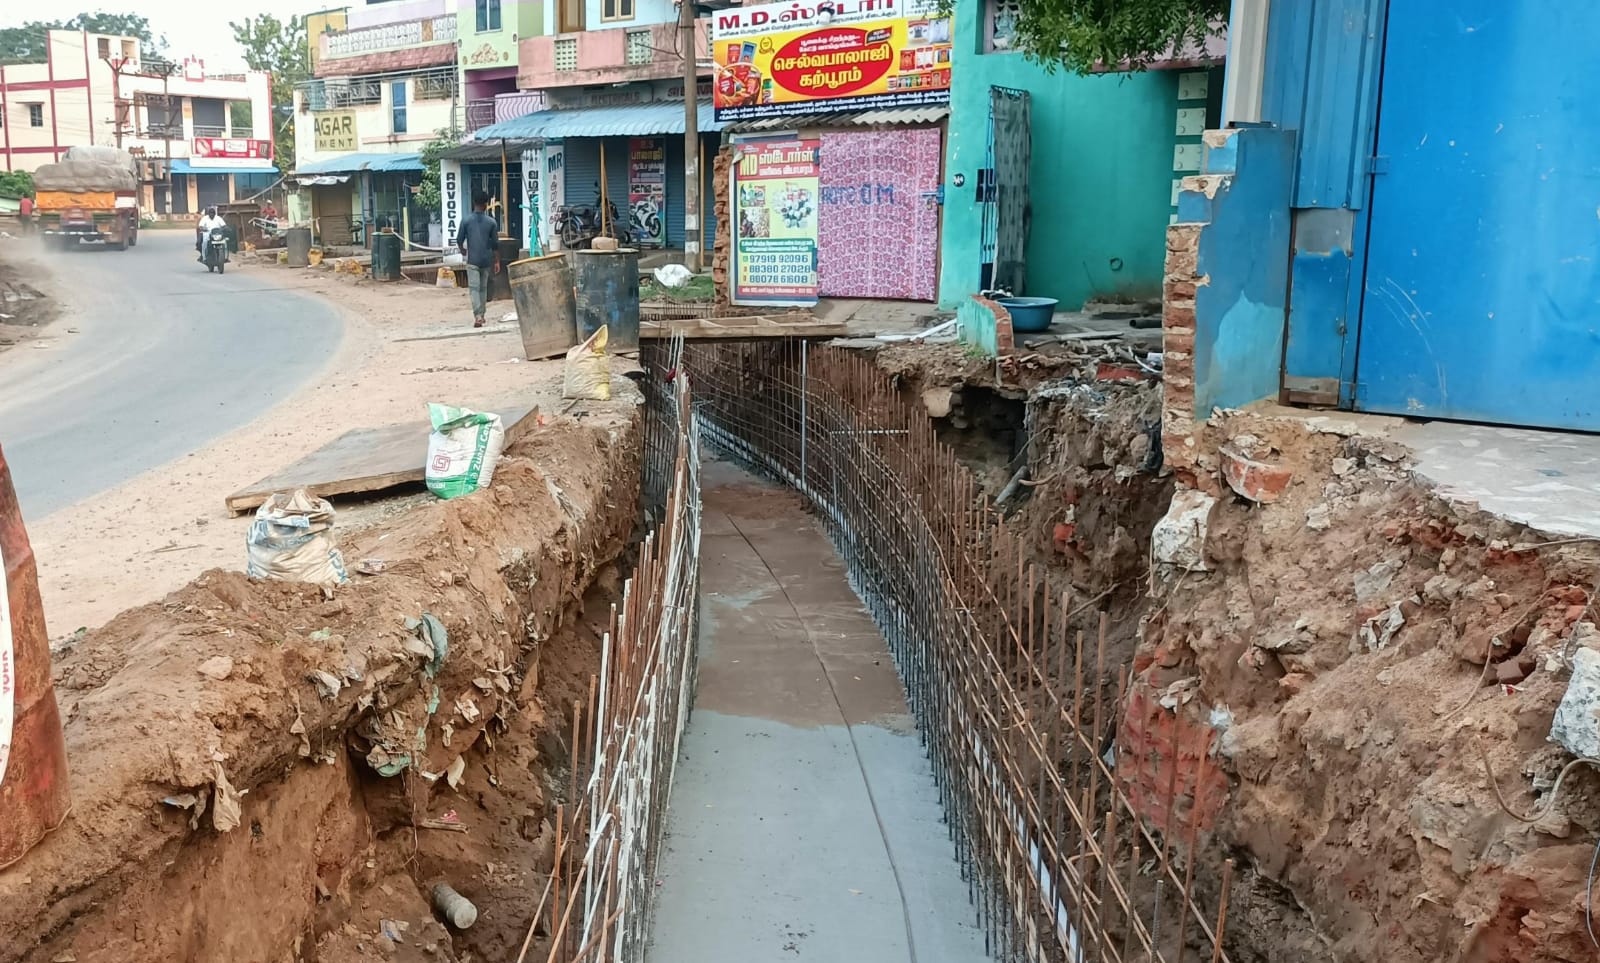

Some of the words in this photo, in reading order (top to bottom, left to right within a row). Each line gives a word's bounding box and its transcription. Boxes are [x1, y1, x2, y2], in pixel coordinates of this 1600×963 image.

[774, 44, 890, 72] செல்வபாலாஜி
[799, 66, 863, 90] கற்பூரம்
[314, 116, 352, 136] AGAR
[315, 138, 353, 148] MENT
[548, 152, 563, 173] MR
[446, 172, 458, 247] ADVOCATE
[750, 255, 776, 263] 97919
[779, 255, 808, 263] 92096
